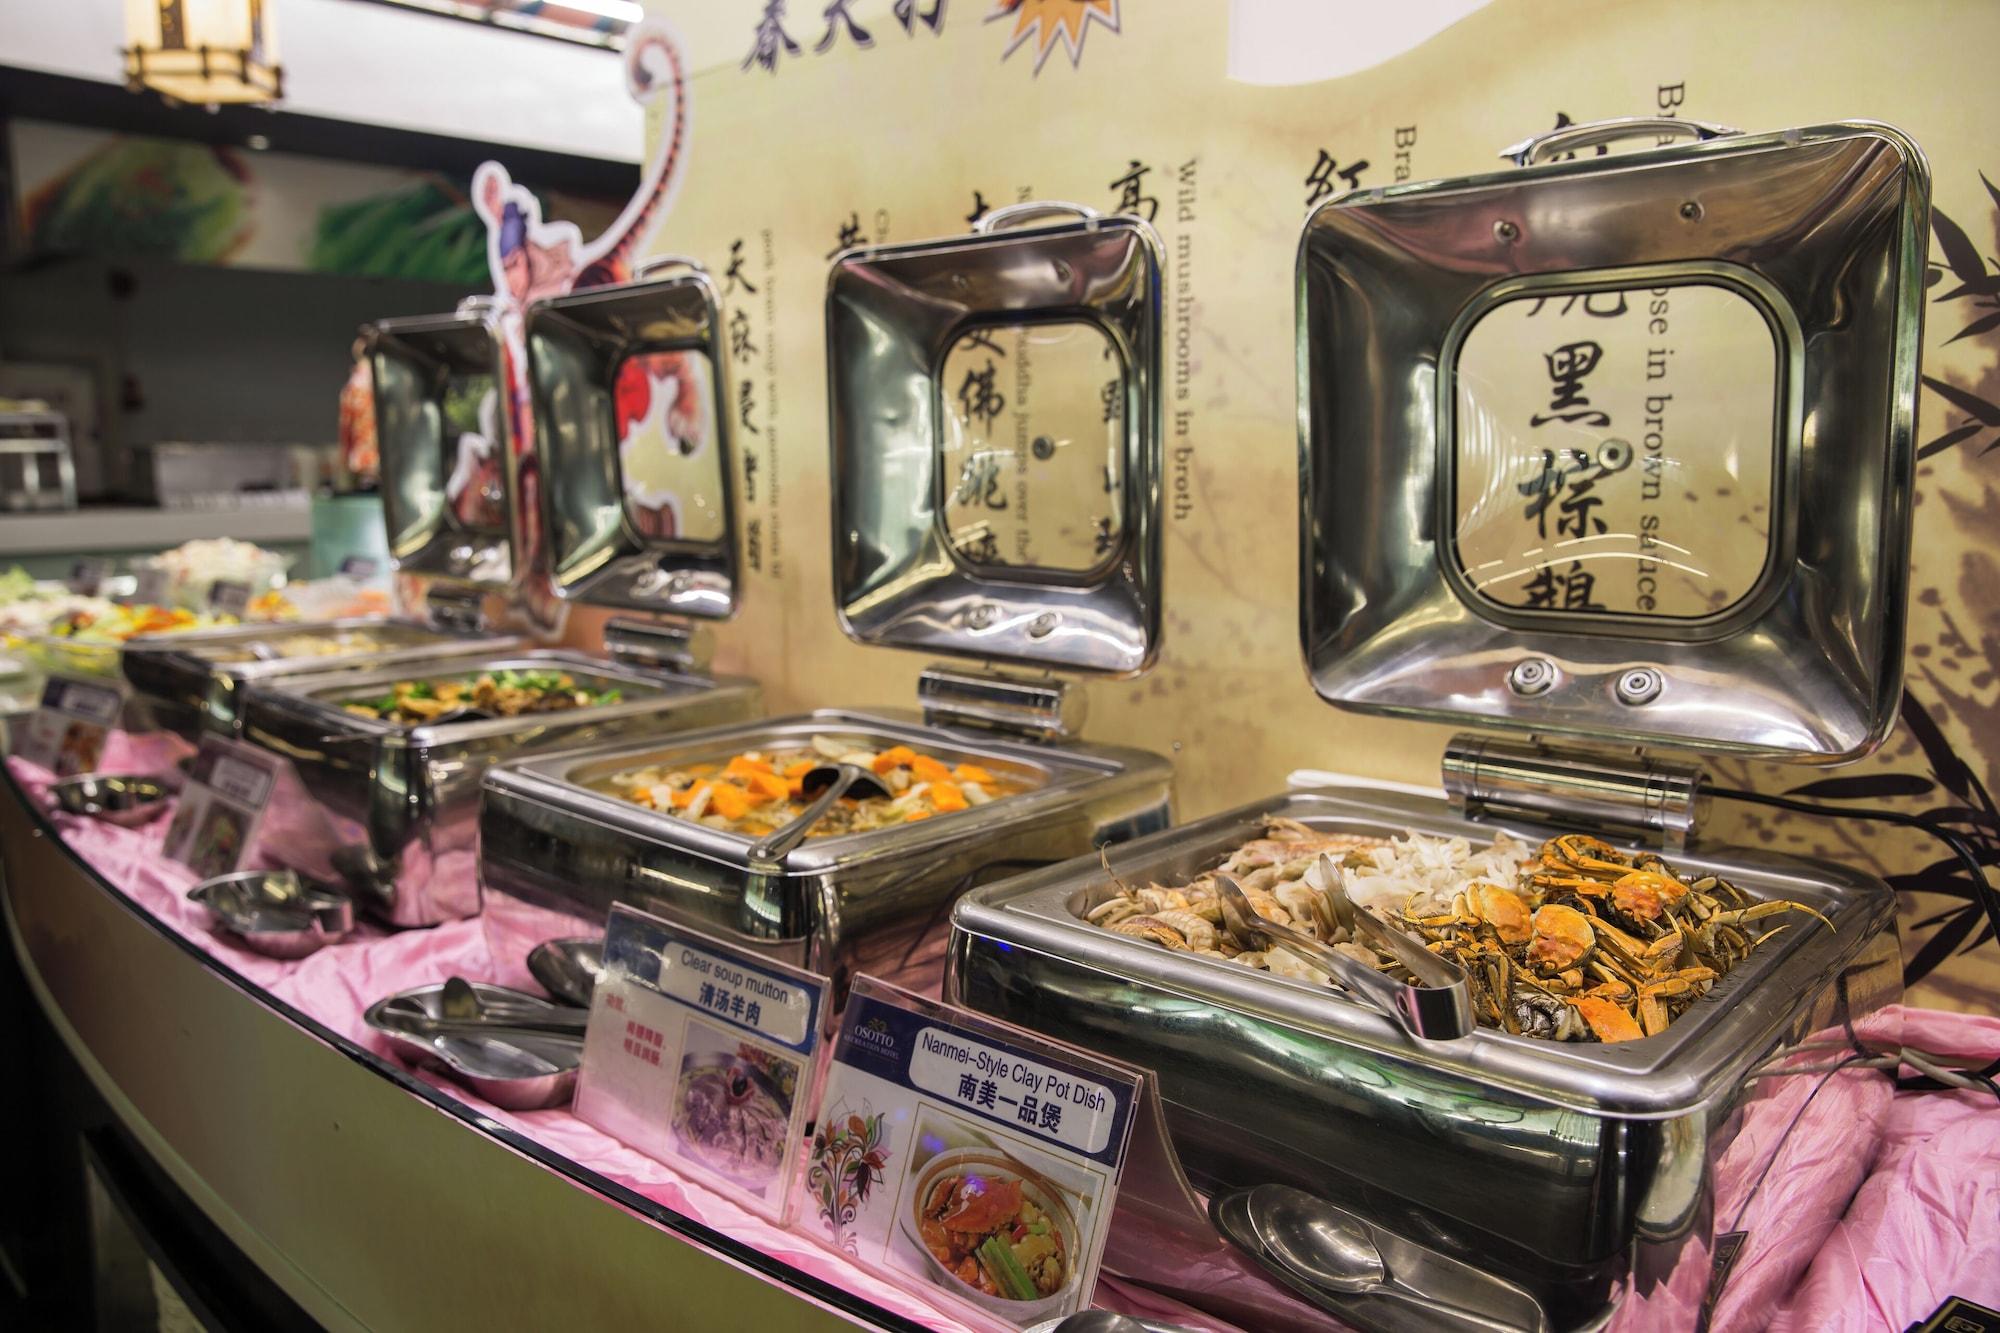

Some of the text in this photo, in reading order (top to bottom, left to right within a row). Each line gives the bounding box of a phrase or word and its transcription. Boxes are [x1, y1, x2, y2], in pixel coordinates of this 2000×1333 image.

[1394, 125, 1417, 182] Bra
[1015, 327, 1033, 406] uddha
[1174, 157, 1199, 521] Wild mushrooms in broth
[1646, 348, 1675, 382] in
[1641, 394, 1673, 501] brown
[1636, 515, 1660, 611] sauce
[681, 949, 788, 1004] Clear soup mutton
[699, 981, 761, 1026] 清汤羊肉
[854, 1024, 895, 1048] OSOTTO
[957, 1073, 1062, 1134] 南美一品煲
[1012, 1063, 1043, 1094] Clay
[1045, 1075, 1071, 1100] Pot
[1073, 1084, 1106, 1113] Dish
